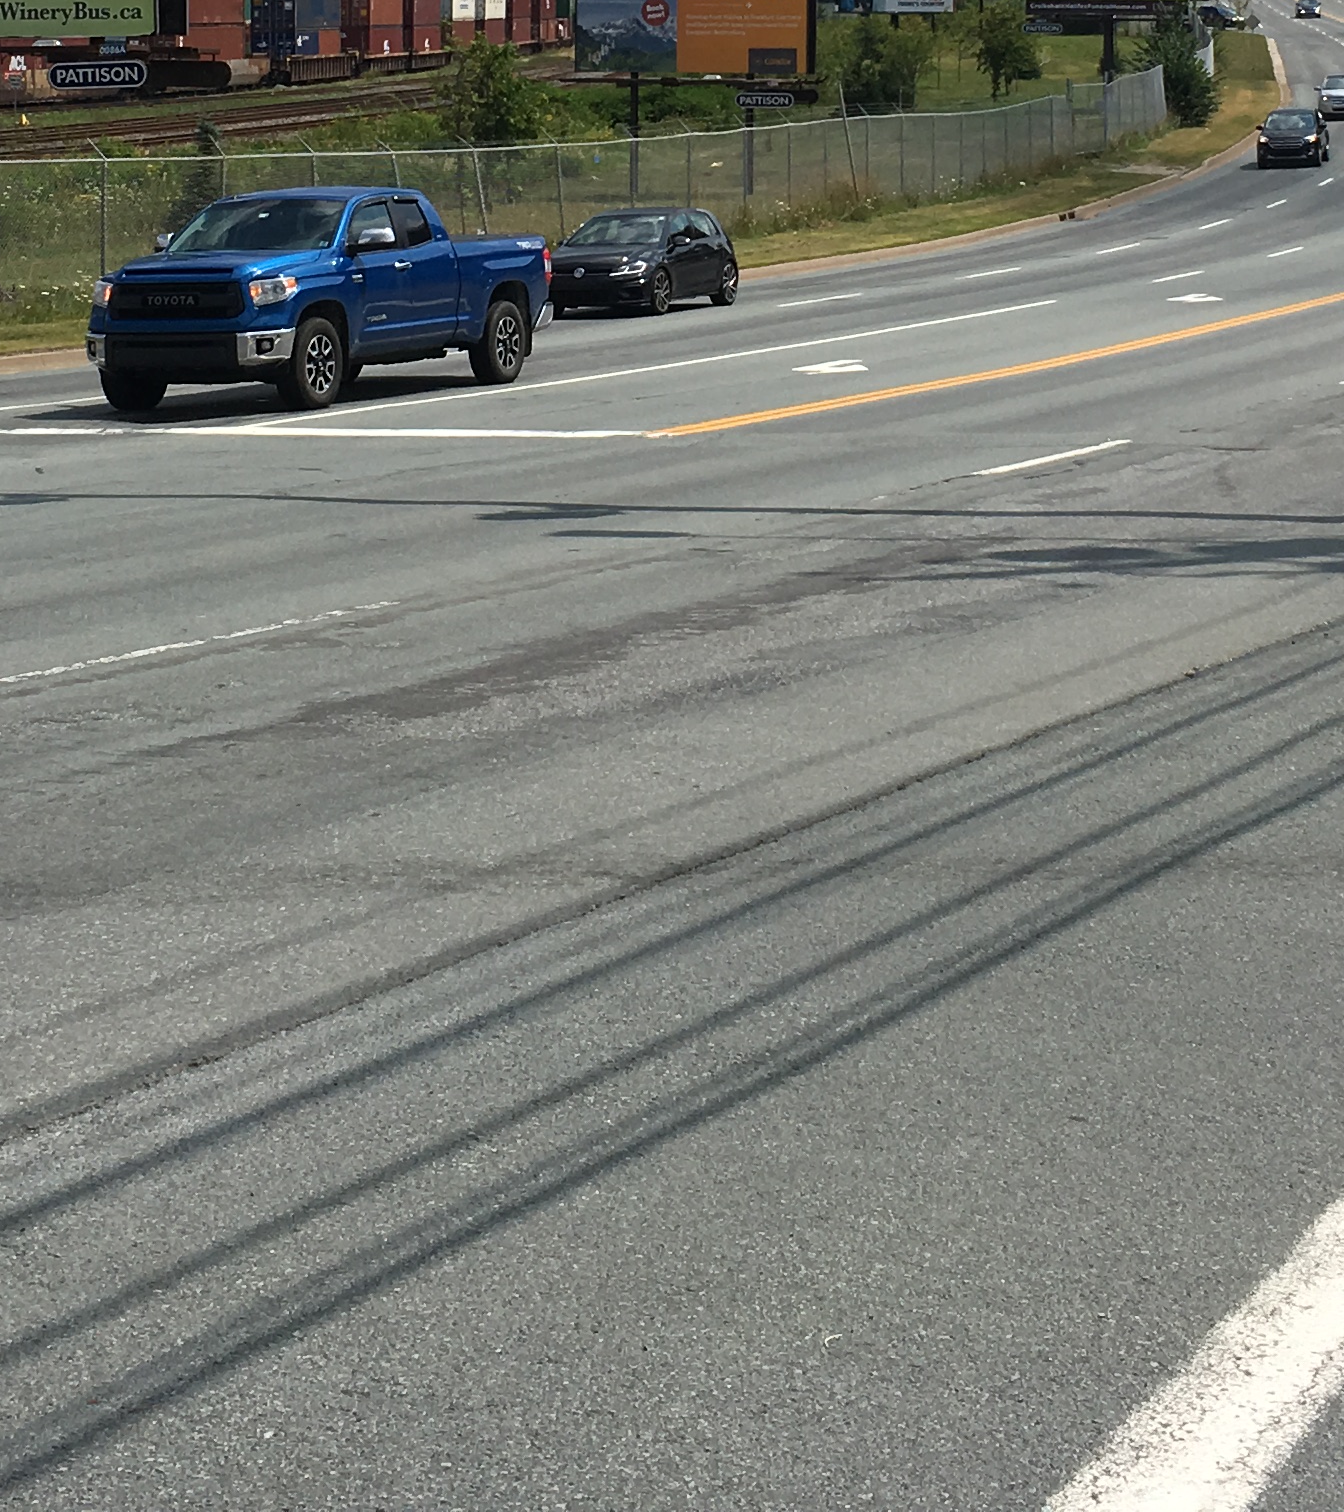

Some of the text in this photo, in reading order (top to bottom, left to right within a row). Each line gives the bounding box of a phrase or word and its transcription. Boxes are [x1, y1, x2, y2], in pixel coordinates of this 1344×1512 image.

[8, 55, 27, 71] ACL
[56, 66, 139, 84] PATTISON
[739, 96, 789, 106] PATTISON
[146, 295, 196, 306] TOYOTA
